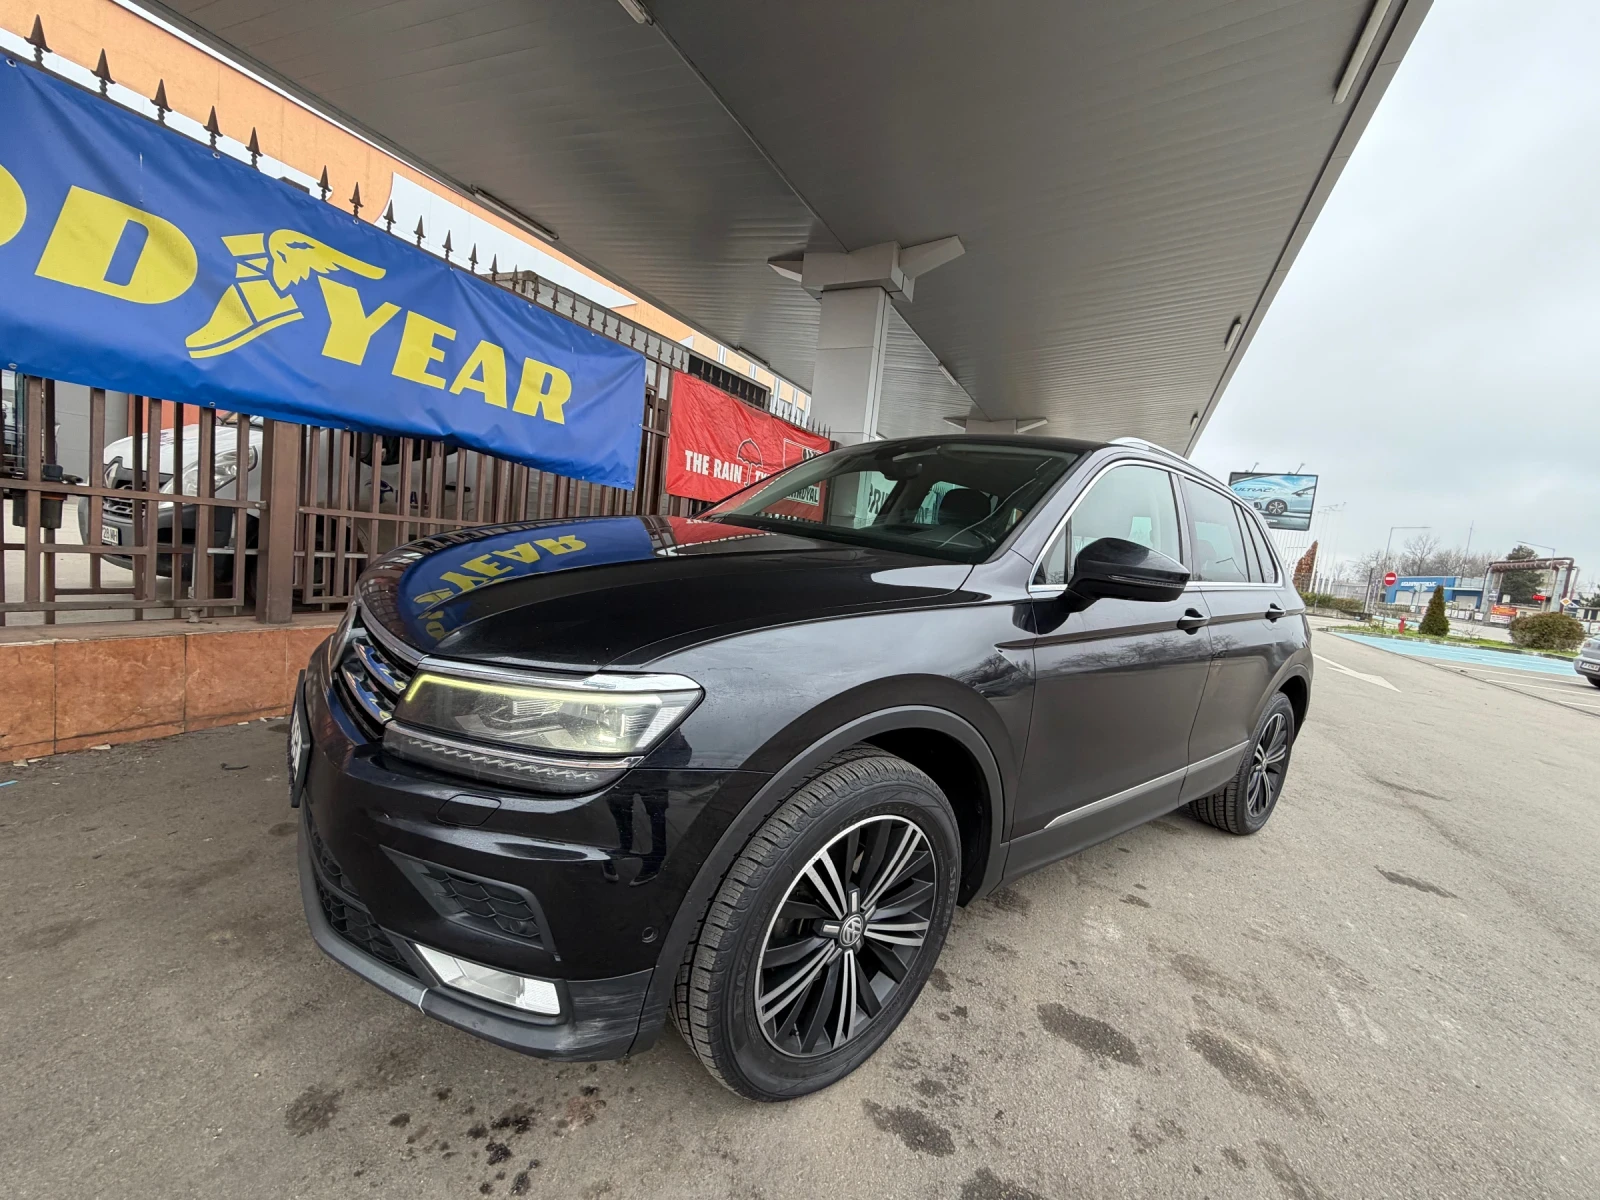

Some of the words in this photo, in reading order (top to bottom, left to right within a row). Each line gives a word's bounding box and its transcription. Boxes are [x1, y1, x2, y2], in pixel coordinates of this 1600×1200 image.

[0, 164, 198, 305] D
[317, 274, 573, 426] YEAR
[685, 449, 710, 476] THE
[713, 458, 743, 484] RAIN
